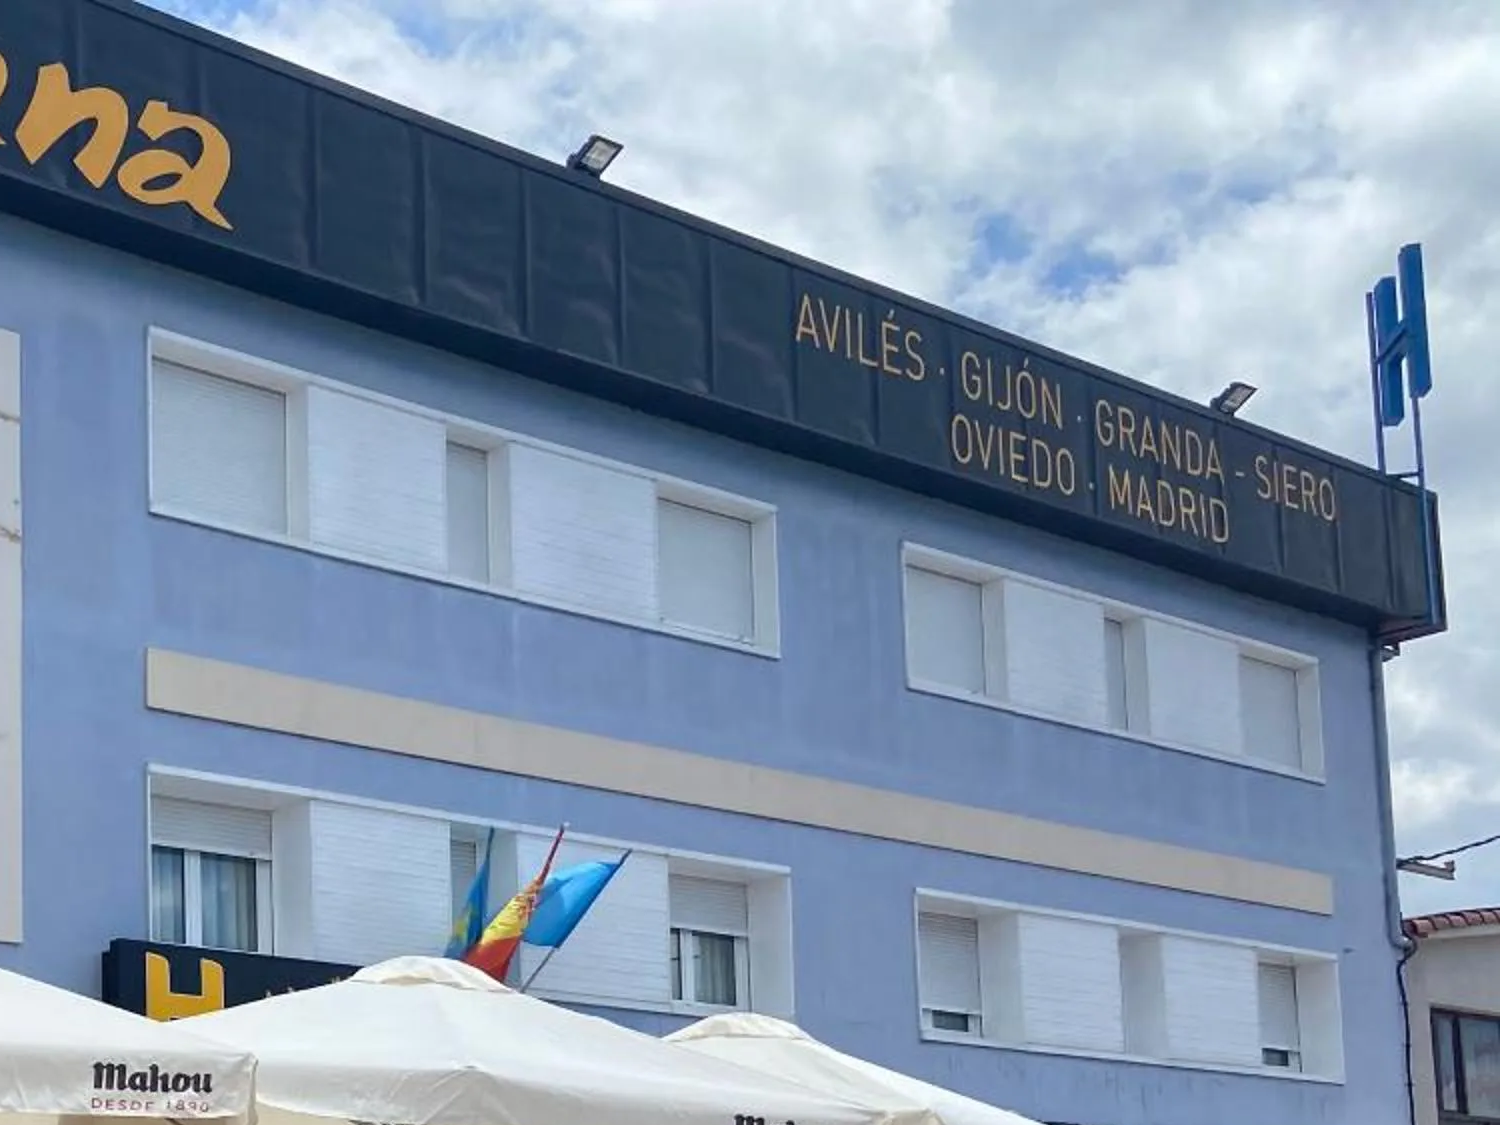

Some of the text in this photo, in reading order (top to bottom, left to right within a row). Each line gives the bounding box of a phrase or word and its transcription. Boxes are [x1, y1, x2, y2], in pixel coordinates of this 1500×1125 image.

[795, 292, 926, 382] AVILÉS
[960, 350, 1064, 431] GIJÓN
[1094, 399, 1226, 484] GRANDA
[1254, 454, 1336, 522] SIERO
[950, 413, 1230, 543] OVIEDO MADRID
[93, 1062, 213, 1094] Mahou
